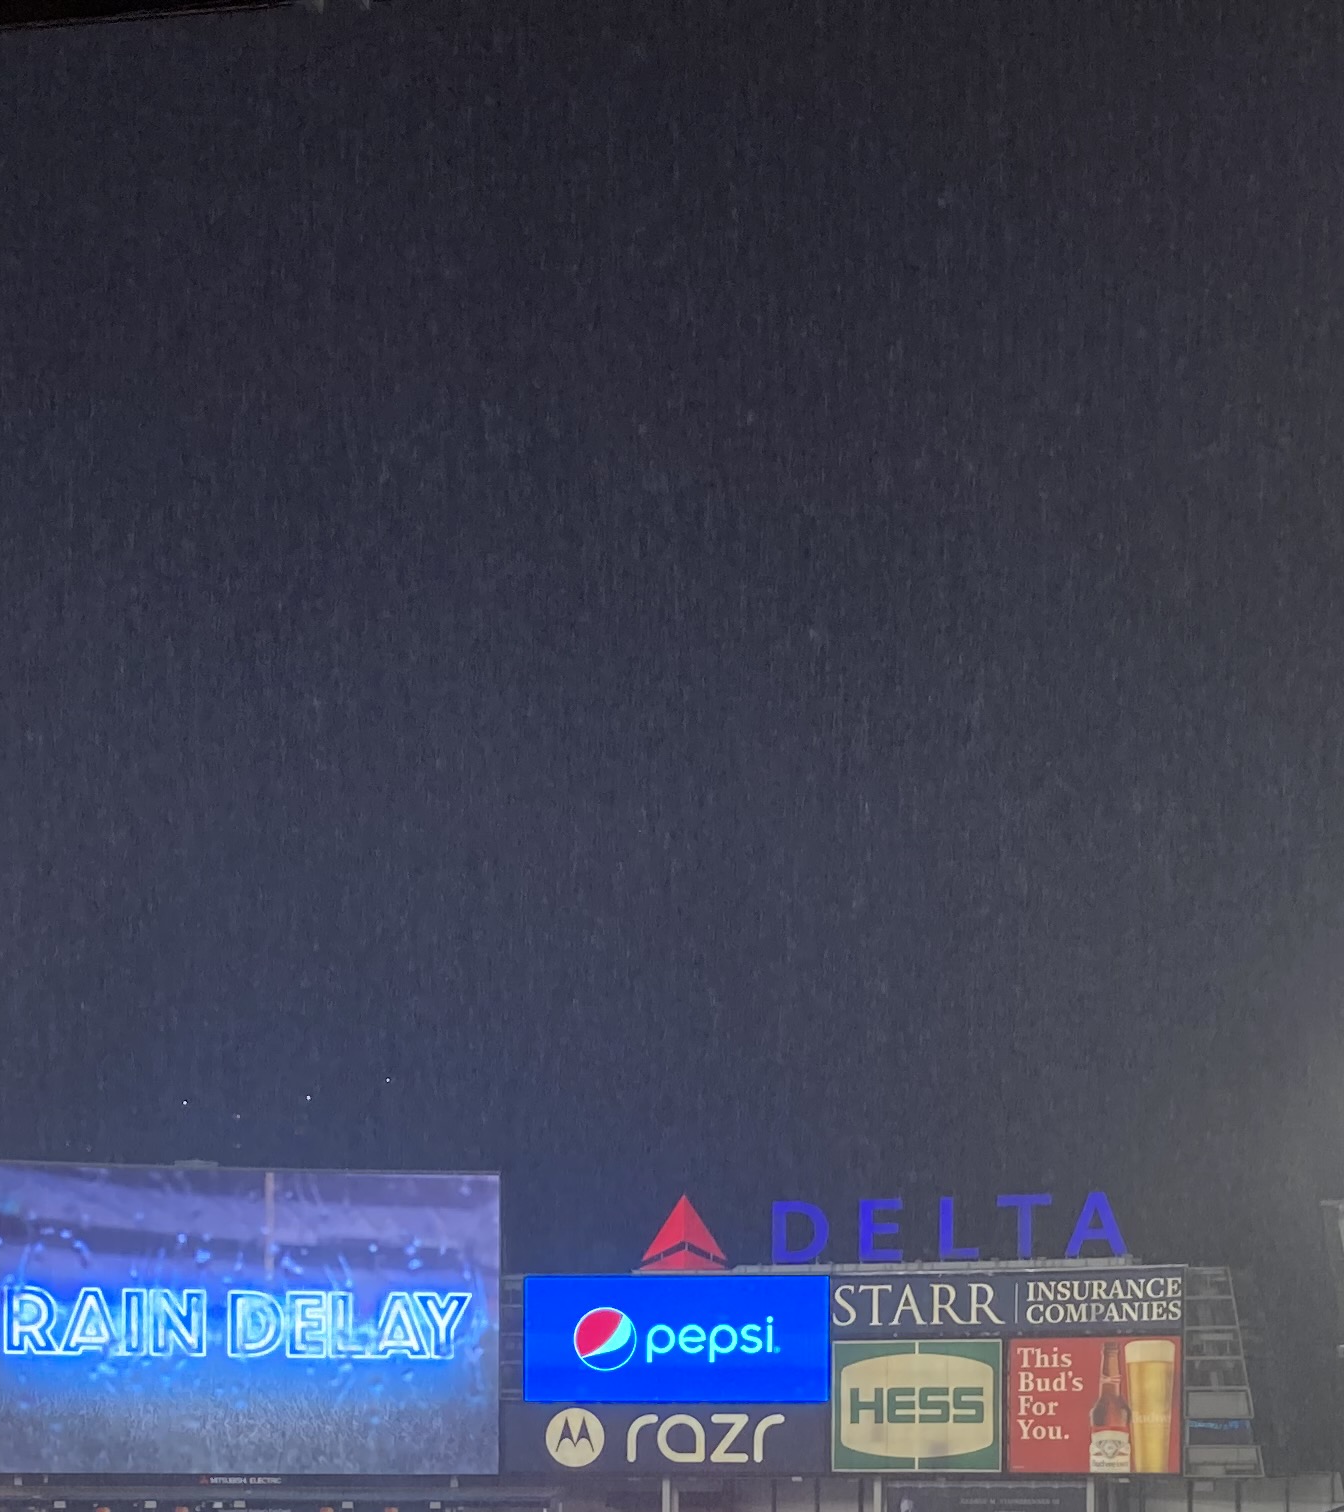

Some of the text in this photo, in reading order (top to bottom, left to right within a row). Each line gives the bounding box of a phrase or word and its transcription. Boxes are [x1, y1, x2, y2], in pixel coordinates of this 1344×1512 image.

[770, 1191, 1128, 1264] DELTA
[832, 1277, 1181, 1328] STARR INSURANCE
[1025, 1300, 1182, 1325] COMPANIES
[2, 1285, 472, 1360] RAIN DELAY
[646, 1316, 775, 1363] pepsi
[1017, 1347, 1072, 1368] This
[1018, 1371, 1083, 1392] Bud's
[849, 1386, 985, 1425] HESS
[1018, 1395, 1058, 1416] For
[627, 1413, 785, 1463] razr
[1017, 1420, 1069, 1440] You.
